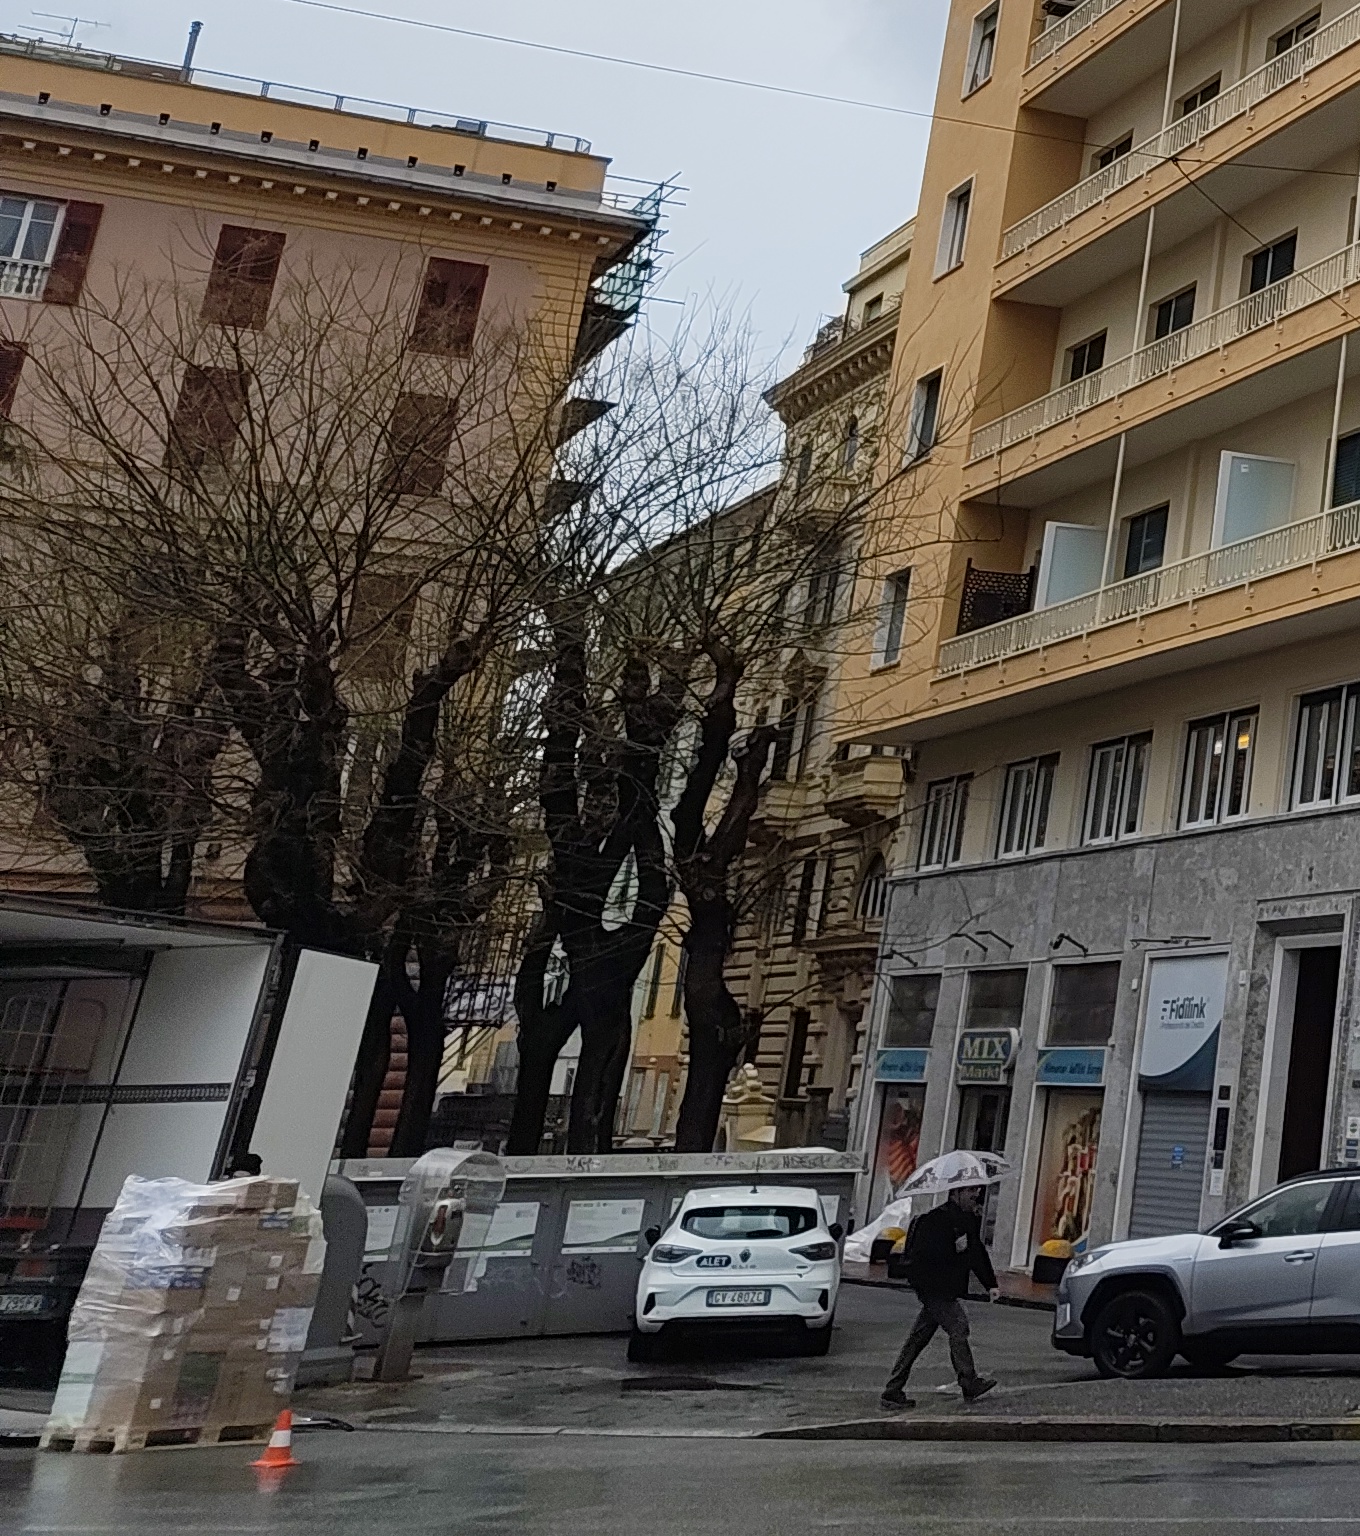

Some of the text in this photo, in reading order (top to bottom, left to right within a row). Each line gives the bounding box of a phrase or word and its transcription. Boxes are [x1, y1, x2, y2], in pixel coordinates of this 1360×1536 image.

[961, 1037, 1009, 1060] MIX
[962, 1065, 1001, 1079] Markt
[700, 1257, 728, 1267] ALET
